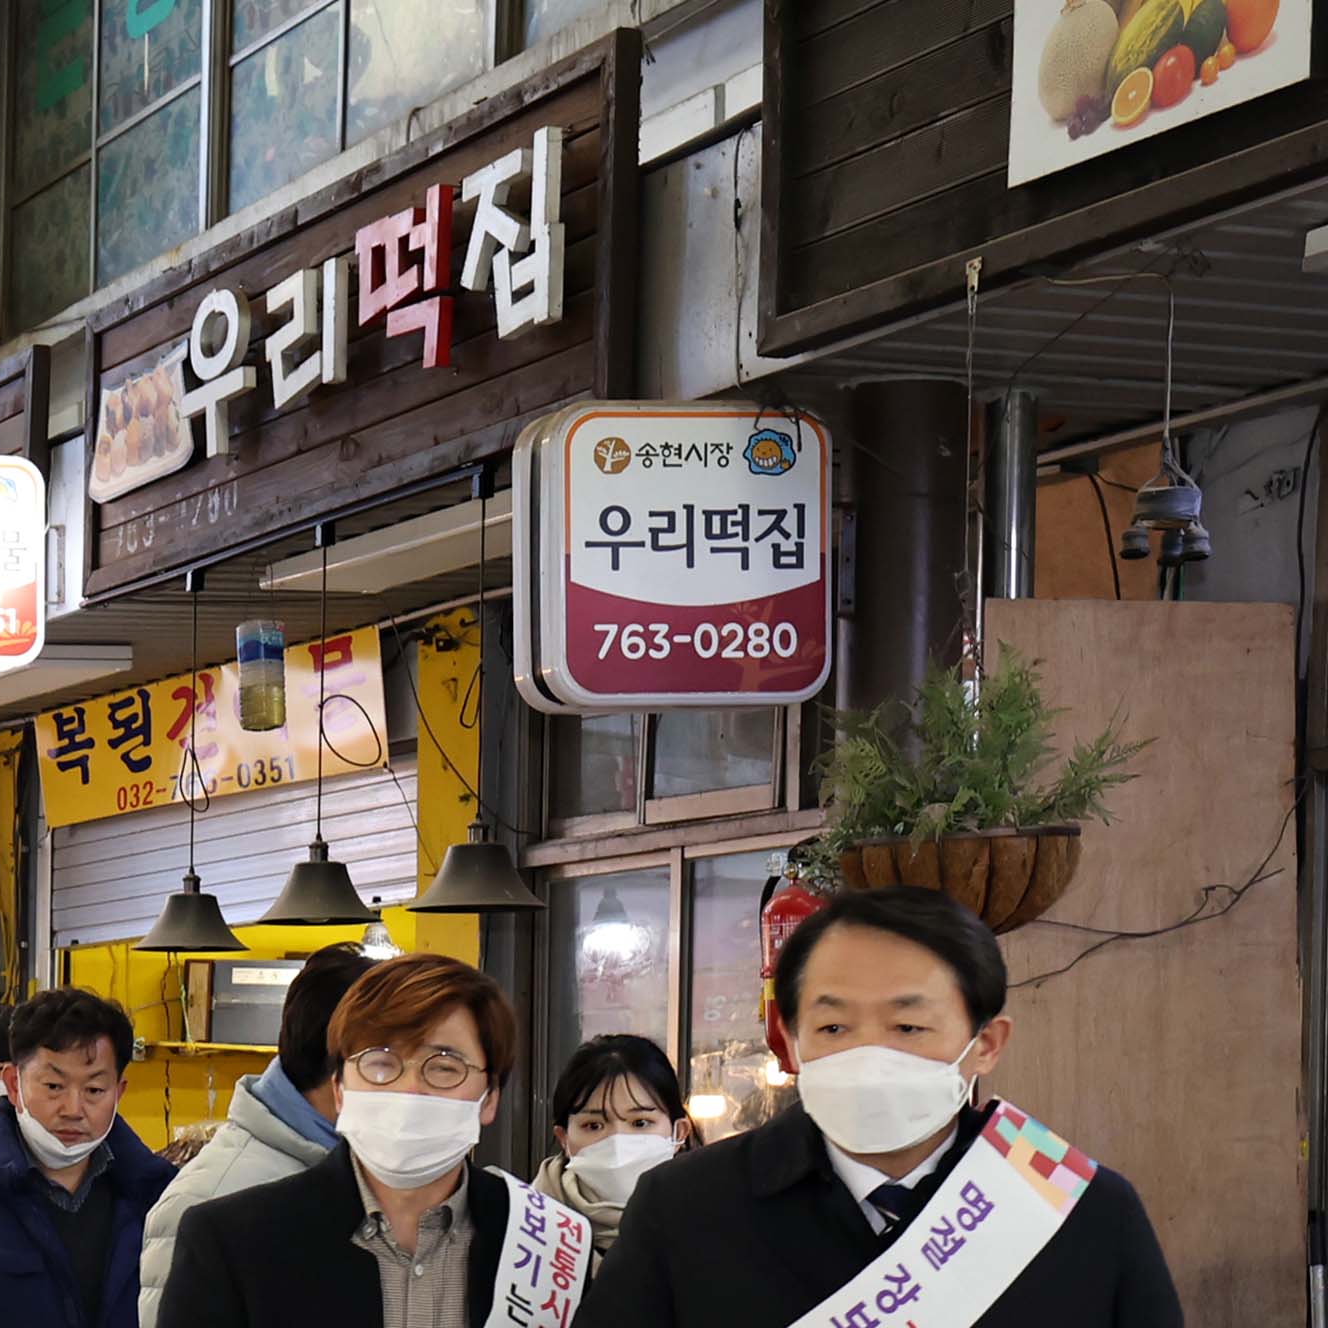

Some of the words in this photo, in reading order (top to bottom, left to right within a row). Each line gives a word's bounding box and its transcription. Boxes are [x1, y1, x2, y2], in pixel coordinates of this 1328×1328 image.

[181, 127, 564, 458] 우리떡집
[633, 440, 734, 470] 송현시장
[583, 501, 808, 572] 우리떡집
[594, 620, 798, 662] 763-0280
[920, 1180, 995, 1272] 명절
